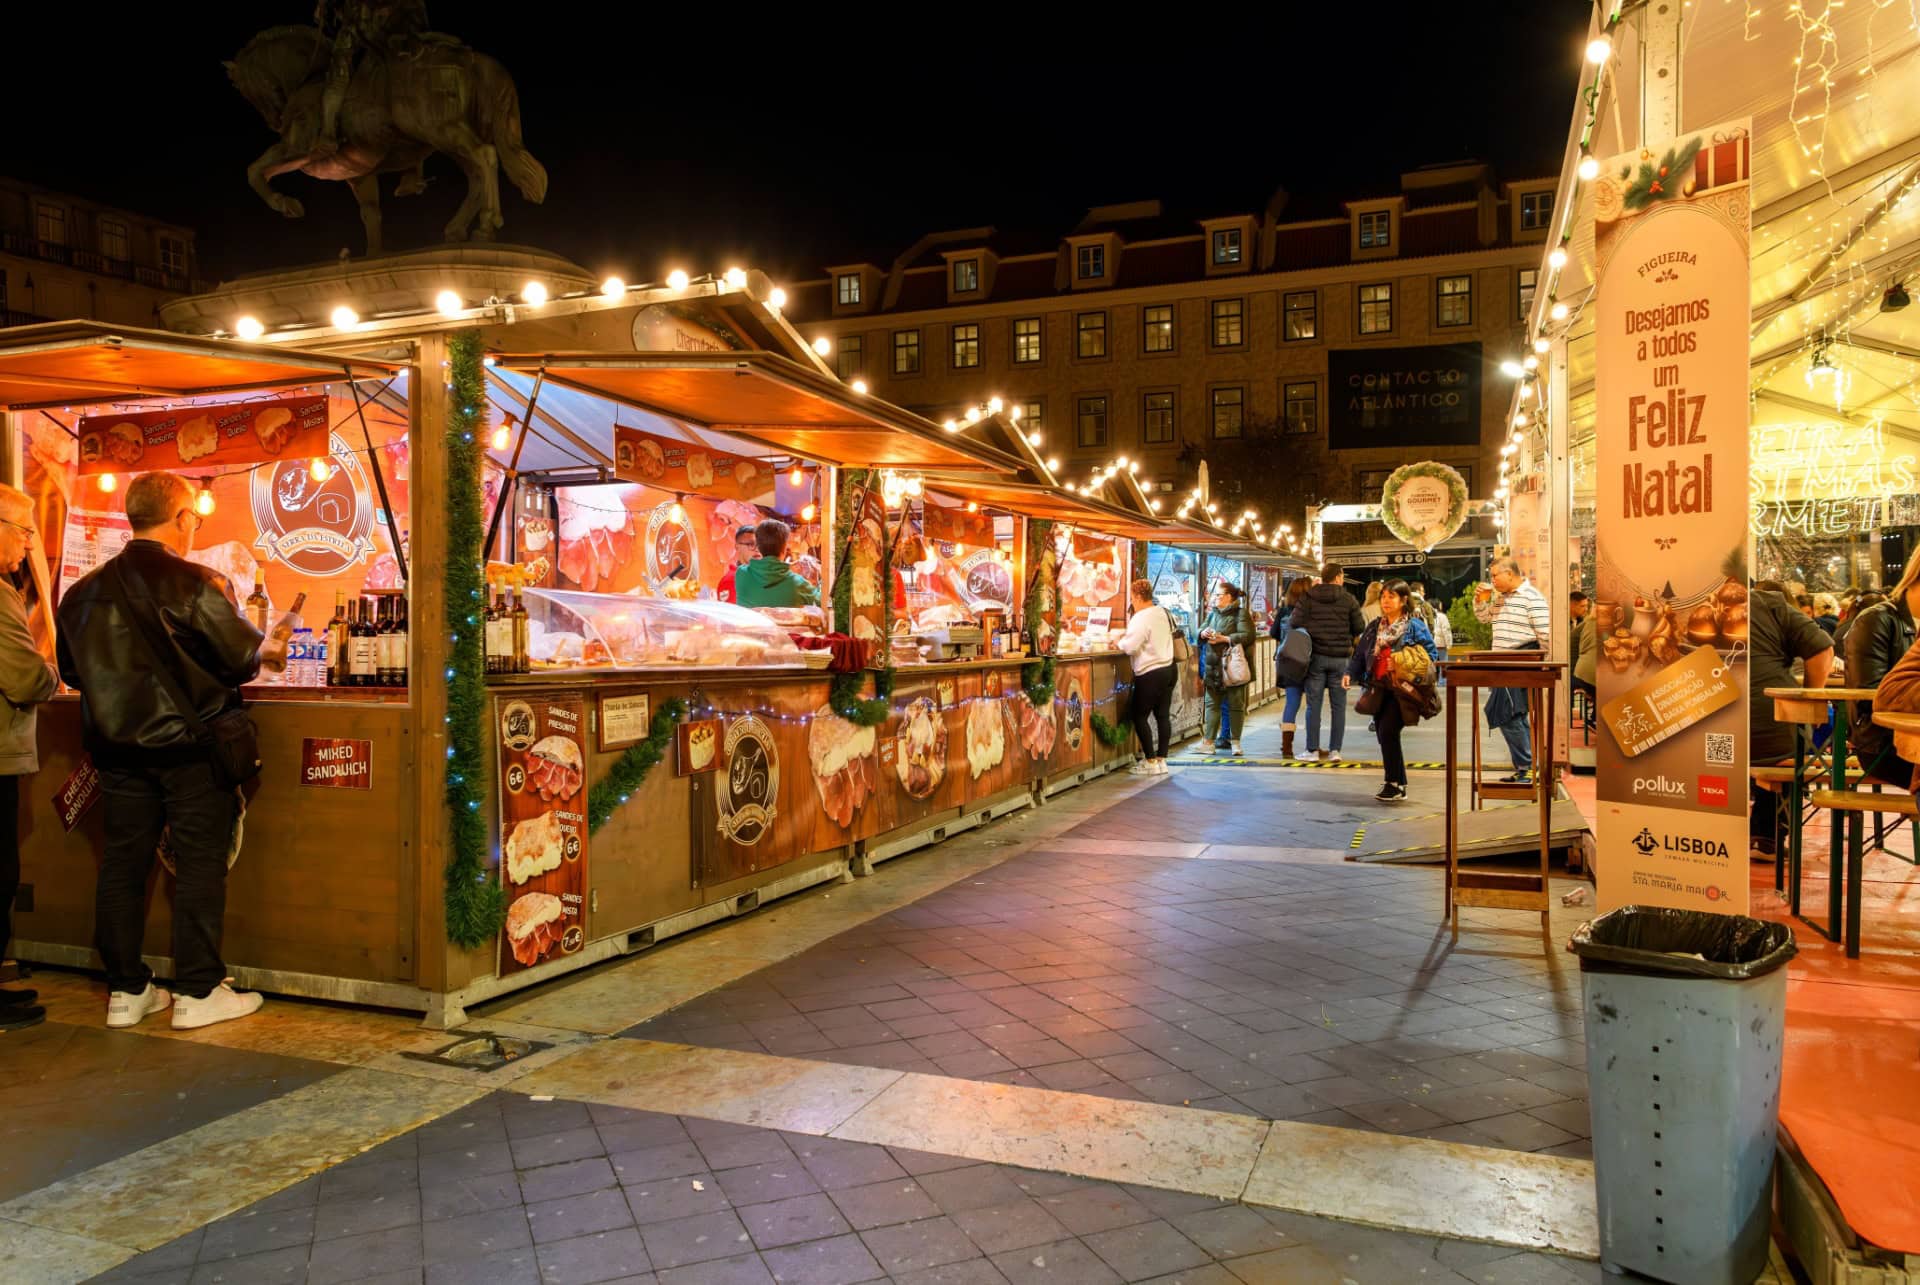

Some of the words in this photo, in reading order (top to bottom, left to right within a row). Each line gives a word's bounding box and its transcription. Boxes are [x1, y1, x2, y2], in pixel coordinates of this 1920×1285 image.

[1637, 251, 1697, 278] FIGUEIRA
[1625, 299, 1709, 335] Desejamos
[1637, 340, 1647, 361] a
[1652, 330, 1697, 358] todos
[1349, 369, 1460, 387] CONTACTO
[1653, 364, 1679, 388] um
[1629, 388, 1707, 451] Feliz
[1623, 453, 1713, 519] Natal
[548, 706, 570, 719] SANDES
[571, 712, 578, 721] DE
[548, 719, 577, 734] PRESUNTO
[318, 745, 353, 762] MIXED
[307, 761, 367, 781] SANDWICH
[509, 771, 522, 786] 6€
[63, 762, 91, 806] CHEESE
[1633, 775, 1687, 794] pollux
[1701, 787, 1726, 796] TEKA
[64, 768, 100, 826] SANDWIC
[555, 810, 576, 820] SANDES
[559, 823, 577, 833] QUEIJO
[566, 840, 579, 854] 6€
[1664, 834, 1729, 859] LISBOA
[562, 892, 582, 904] SANDES
[562, 906, 578, 915] MISTA
